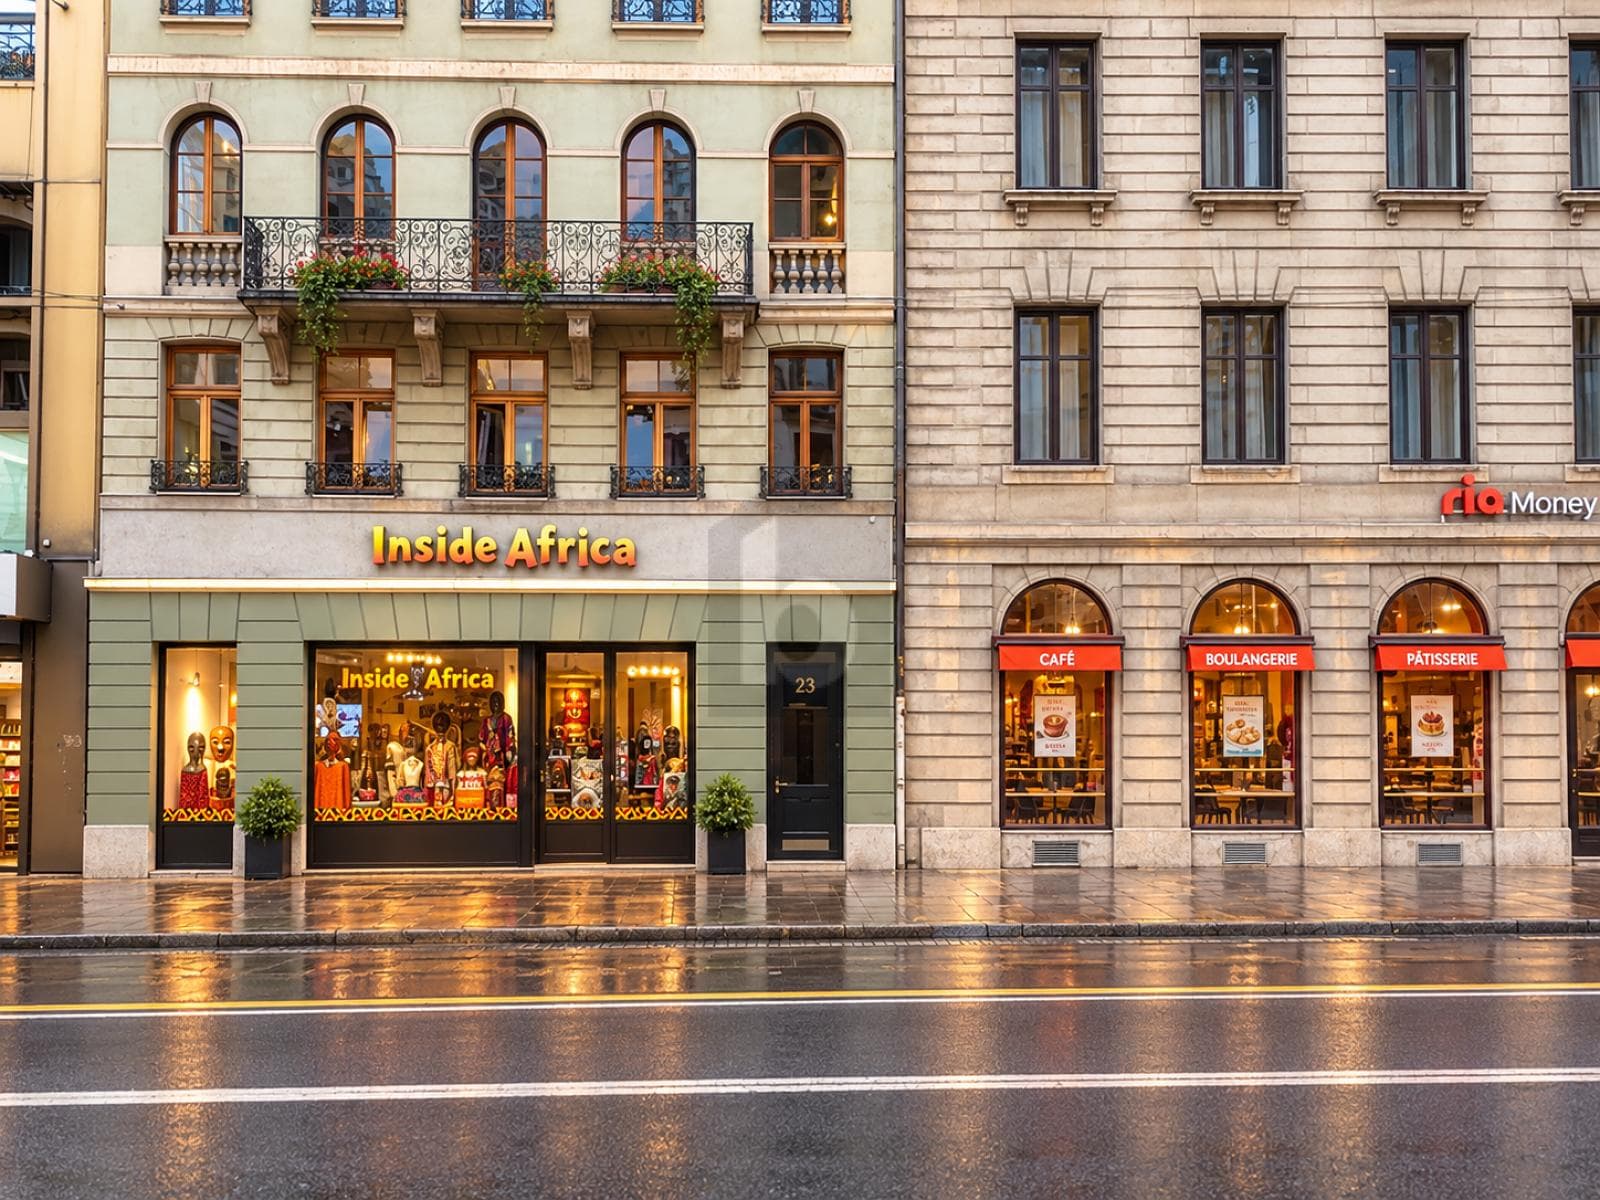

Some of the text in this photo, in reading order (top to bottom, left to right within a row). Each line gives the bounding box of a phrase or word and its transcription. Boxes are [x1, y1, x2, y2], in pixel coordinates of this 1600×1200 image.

[1441, 473, 1597, 520] ria Money
[372, 524, 637, 570] Inside Africa
[1039, 650, 1076, 667] CAFÉ
[1205, 652, 1298, 667] BOULANGERIE
[341, 667, 495, 690] Inside Africa
[795, 677, 816, 694] 23
